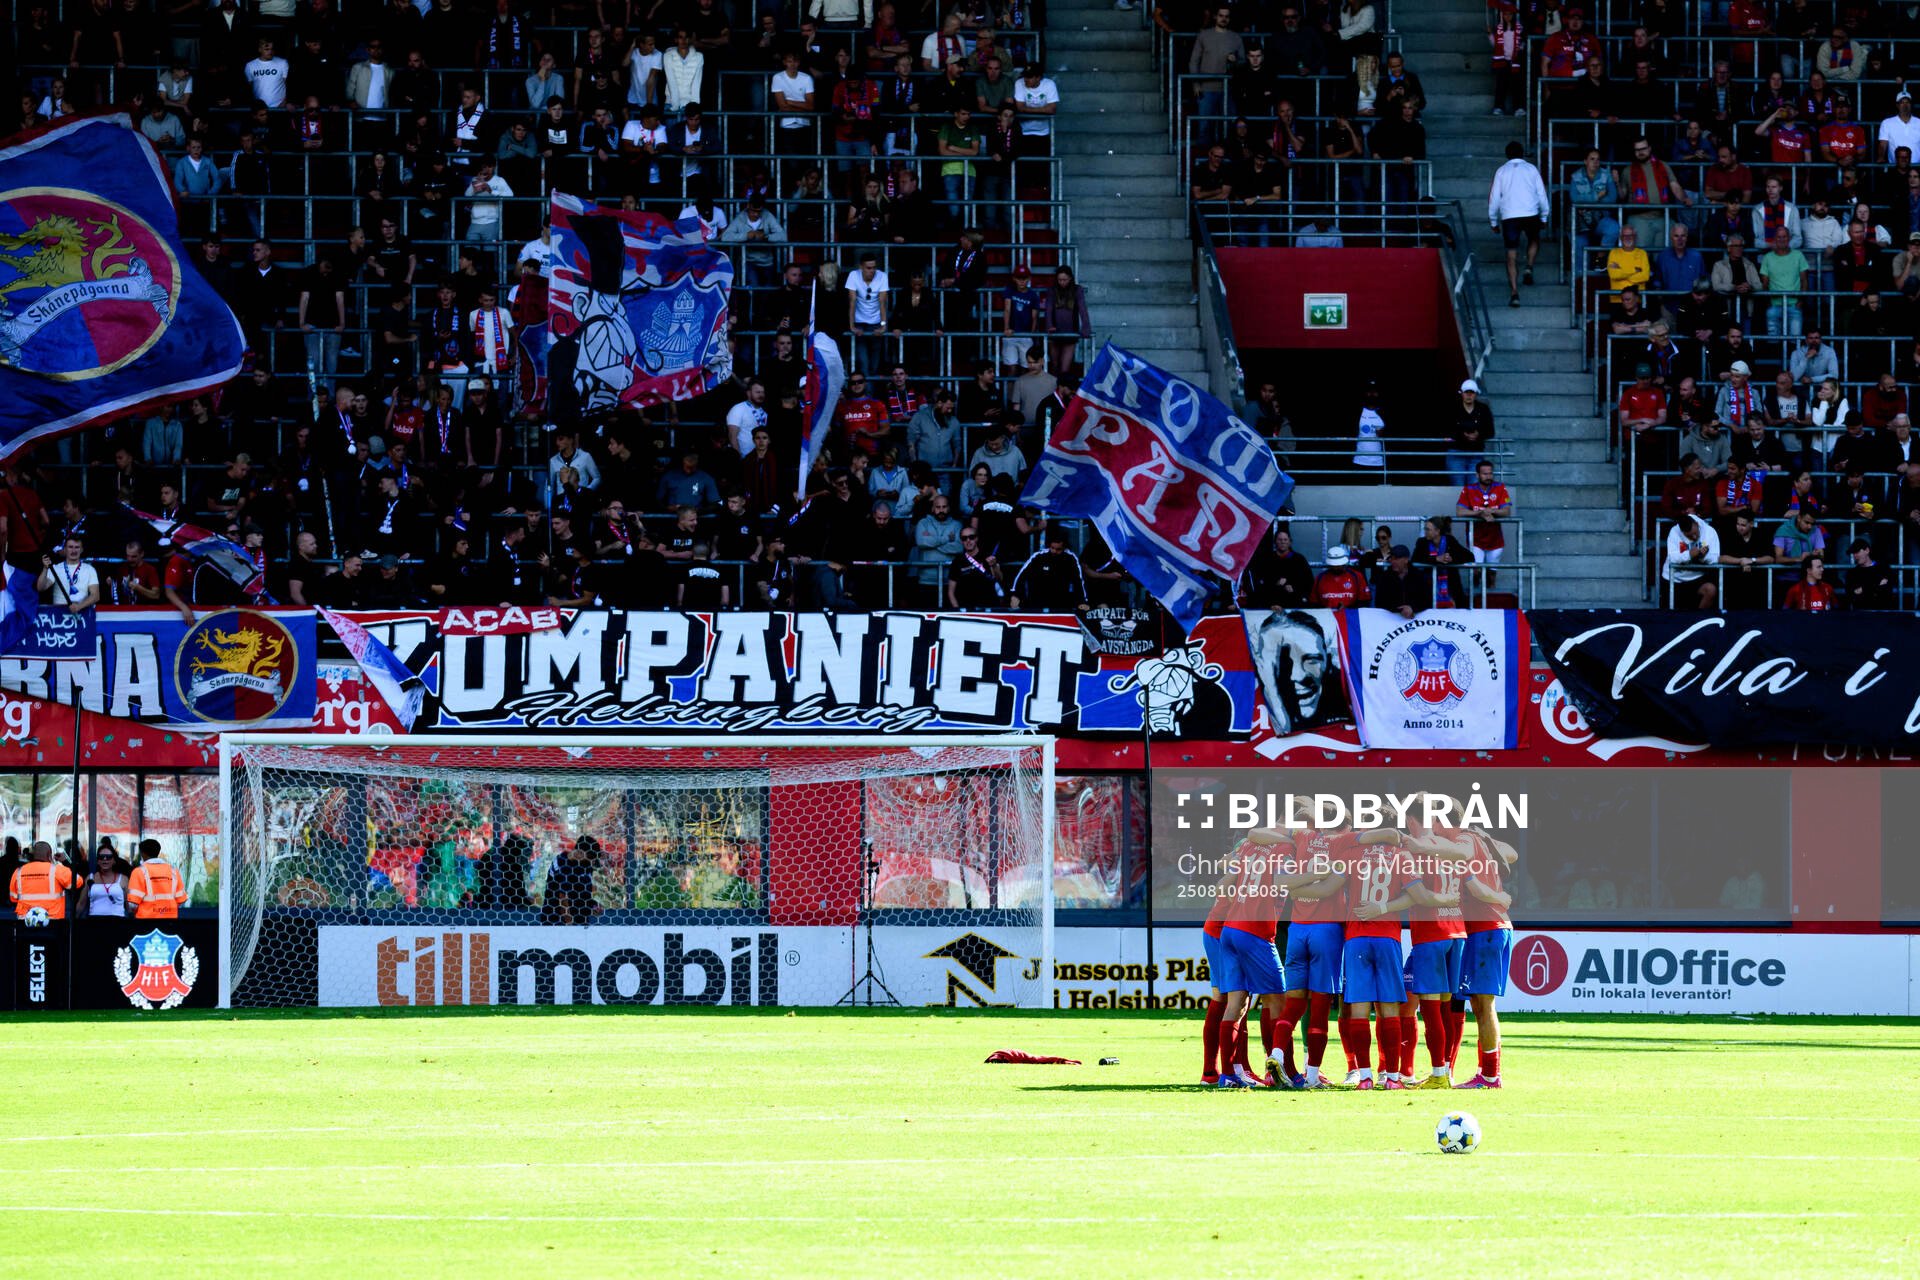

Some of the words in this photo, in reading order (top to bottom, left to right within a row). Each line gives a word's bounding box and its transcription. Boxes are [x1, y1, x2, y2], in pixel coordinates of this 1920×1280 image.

[253, 69, 278, 77] HUGO
[27, 282, 130, 323] Skånepågarna
[442, 606, 560, 634] ACAB
[1086, 607, 1127, 620] SYMPATI
[1369, 619, 1467, 680] Helsingborgs
[1470, 629, 1498, 681] Äldre
[1554, 617, 1807, 700] Vila
[1844, 647, 1891, 697] i
[209, 673, 266, 690] Skånepågarna
[503, 691, 936, 733] Helsingborg
[1403, 719, 1432, 729] Anno
[1435, 719, 1464, 729] 2014
[1361, 864, 1392, 905] 18
[30, 944, 45, 1002] SELECT
[377, 933, 779, 1006] tillmobil
[1574, 948, 1786, 987] AllOffice
[1571, 987, 1595, 998] Din
[1600, 987, 1645, 999] lokala
[1651, 988, 1732, 1000] leverantör!
